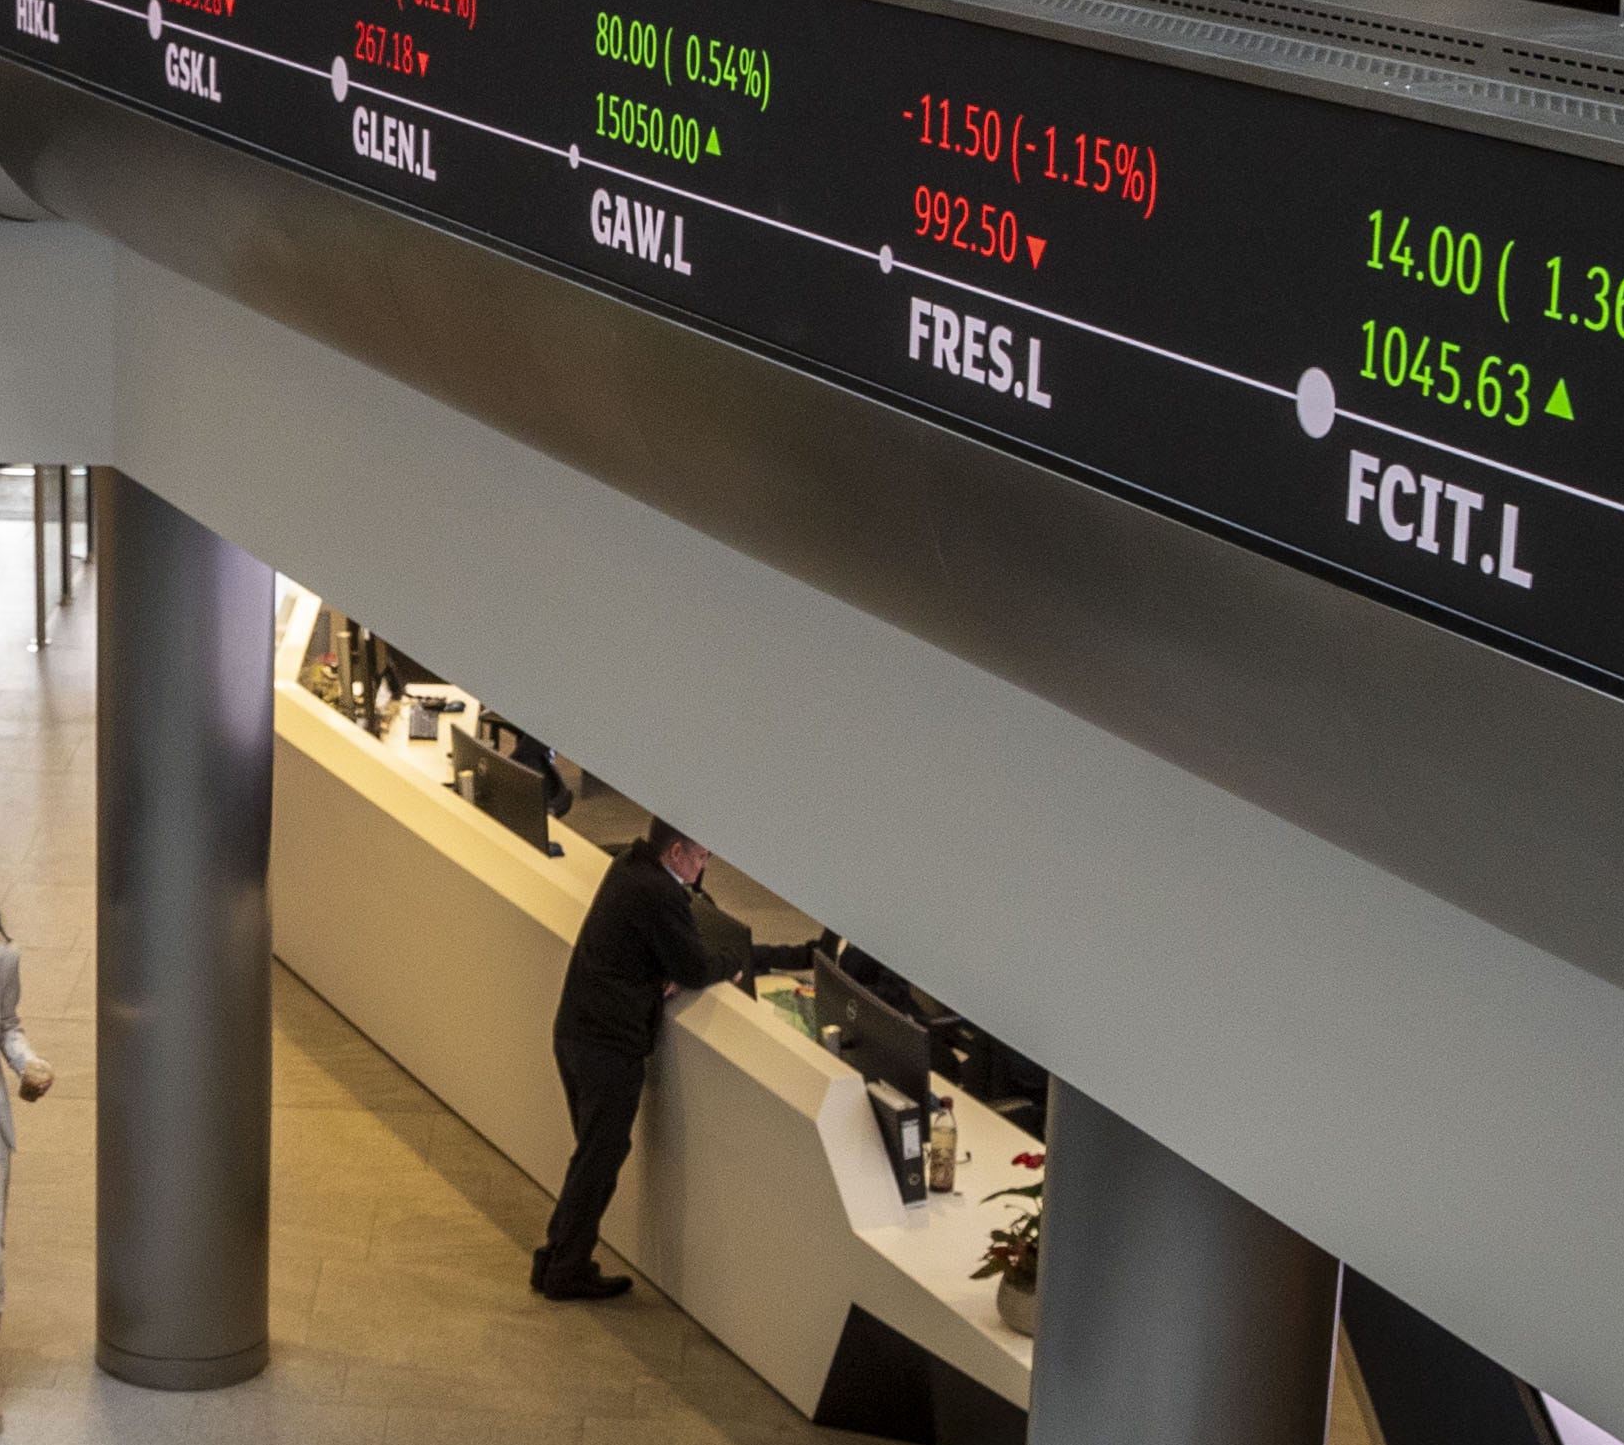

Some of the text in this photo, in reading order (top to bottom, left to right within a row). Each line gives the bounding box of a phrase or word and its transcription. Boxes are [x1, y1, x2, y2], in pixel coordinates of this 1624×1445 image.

[164, 42, 222, 103] GSK.L
[354, 20, 414, 75] 267.18
[595, 11, 658, 70] 80.00
[352, 105, 437, 182] GLEN.L
[595, 92, 700, 165] 15050.00
[902, 93, 1158, 220] -11.50 (-1.15%)
[590, 188, 692, 276] GAW.L
[914, 184, 1018, 264] 992.50
[1366, 209, 1483, 296] 14.00
[908, 296, 1052, 409] FRES.L
[1359, 319, 1531, 427] 1045.63
[1346, 449, 1533, 590] FCIT.L
